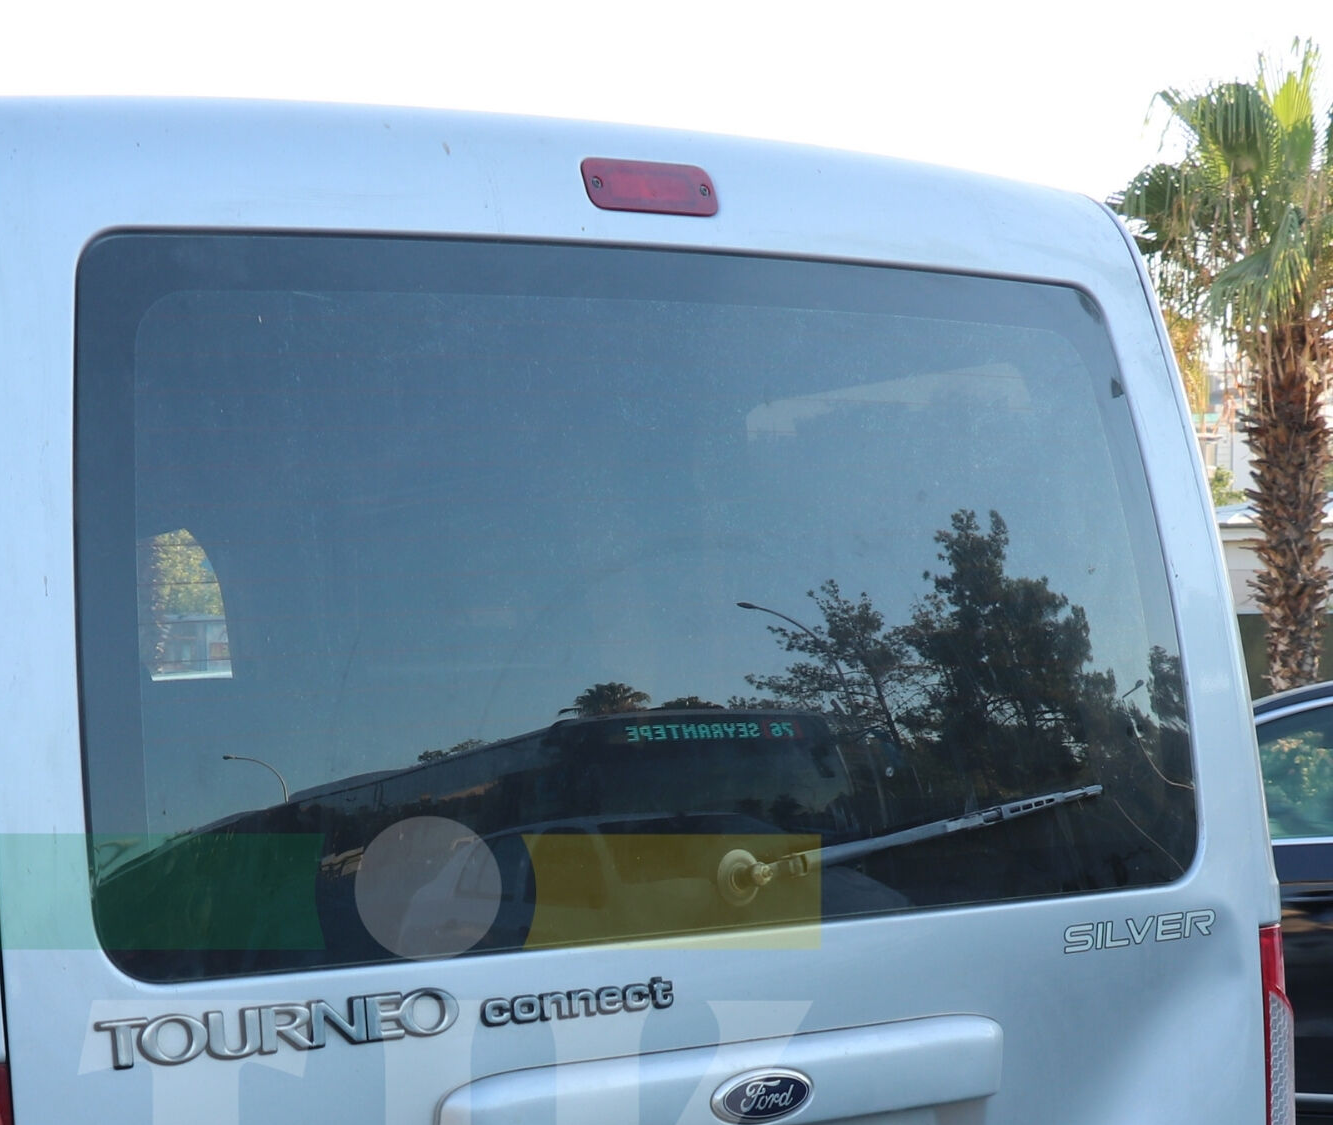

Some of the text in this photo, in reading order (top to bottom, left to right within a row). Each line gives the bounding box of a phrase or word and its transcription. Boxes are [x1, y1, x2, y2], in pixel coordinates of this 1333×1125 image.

[1064, 909, 1216, 954] SILVER
[95, 976, 674, 1070] TOURNEO connect
[740, 1079, 795, 1113] Ford
